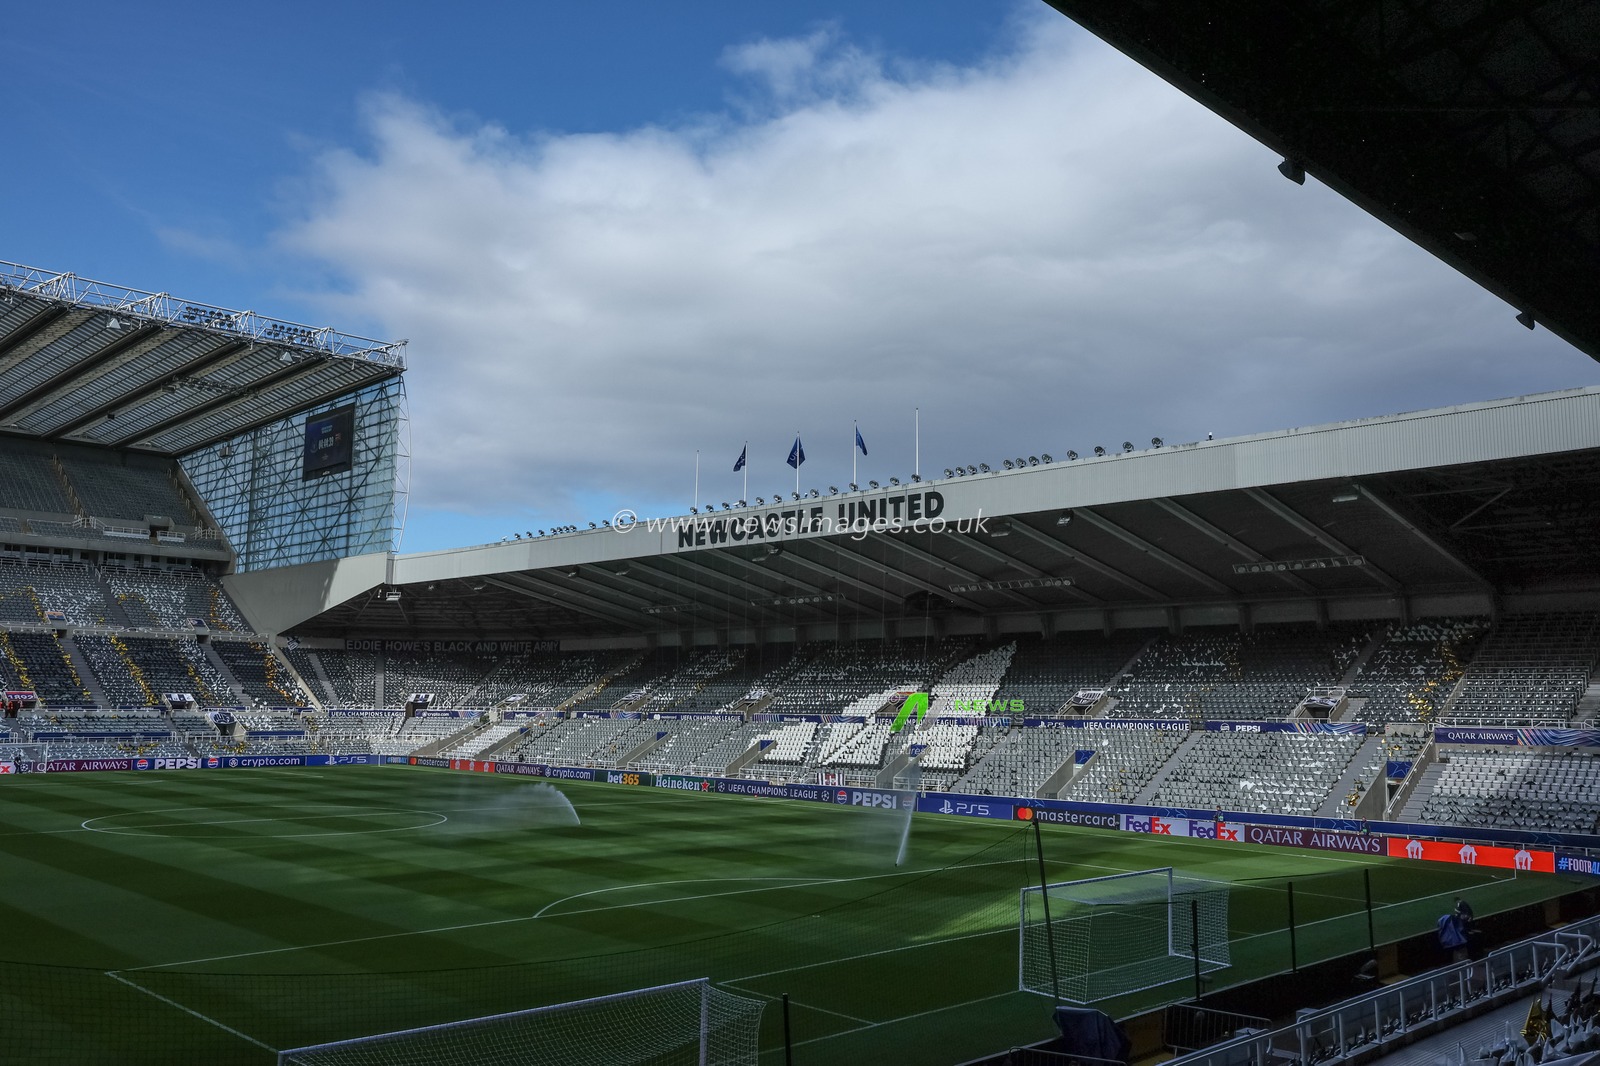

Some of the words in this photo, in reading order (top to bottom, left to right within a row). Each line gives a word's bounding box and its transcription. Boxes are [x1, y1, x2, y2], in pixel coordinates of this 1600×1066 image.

[679, 507, 823, 548] NEWCASTLE
[839, 491, 945, 529] UNITED
[346, 640, 381, 651] EDDIE
[385, 640, 431, 652] HOWE'S
[433, 640, 472, 652] BLACK
[475, 641, 498, 652] AND
[500, 641, 532, 653] WHITE
[534, 641, 559, 653] ARMY
[1083, 721, 1103, 730] UEFA
[1104, 722, 1153, 731] CHAMPIONS
[1155, 722, 1189, 731] LEAGUE
[1447, 731, 1476, 741] QATAR
[1477, 732, 1514, 742] AIRWAYS
[37, 761, 76, 772] QATAR
[81, 760, 128, 771] AIRWAYS
[154, 758, 202, 770] PEPSI
[241, 757, 300, 767] crypto.com
[338, 756, 366, 764] PS5
[418, 758, 449, 767] mastercard
[495, 764, 514, 773] QATAR
[515, 765, 539, 775] AIRWAYS
[552, 768, 590, 779] crypto.com
[607, 771, 639, 785] bet365
[656, 776, 700, 790] Heineken
[728, 784, 746, 793] UEFA
[747, 785, 788, 796] CHAMPIONS
[790, 789, 819, 799] LEAGUE
[852, 791, 896, 810] PEPSI
[956, 802, 990, 816] PS5
[1036, 810, 1116, 827] mastercard
[1125, 815, 1171, 835] FedEx
[1189, 819, 1238, 842] FedEx
[1251, 828, 1303, 845] QATAR
[1309, 833, 1380, 853] AIRWAYS
